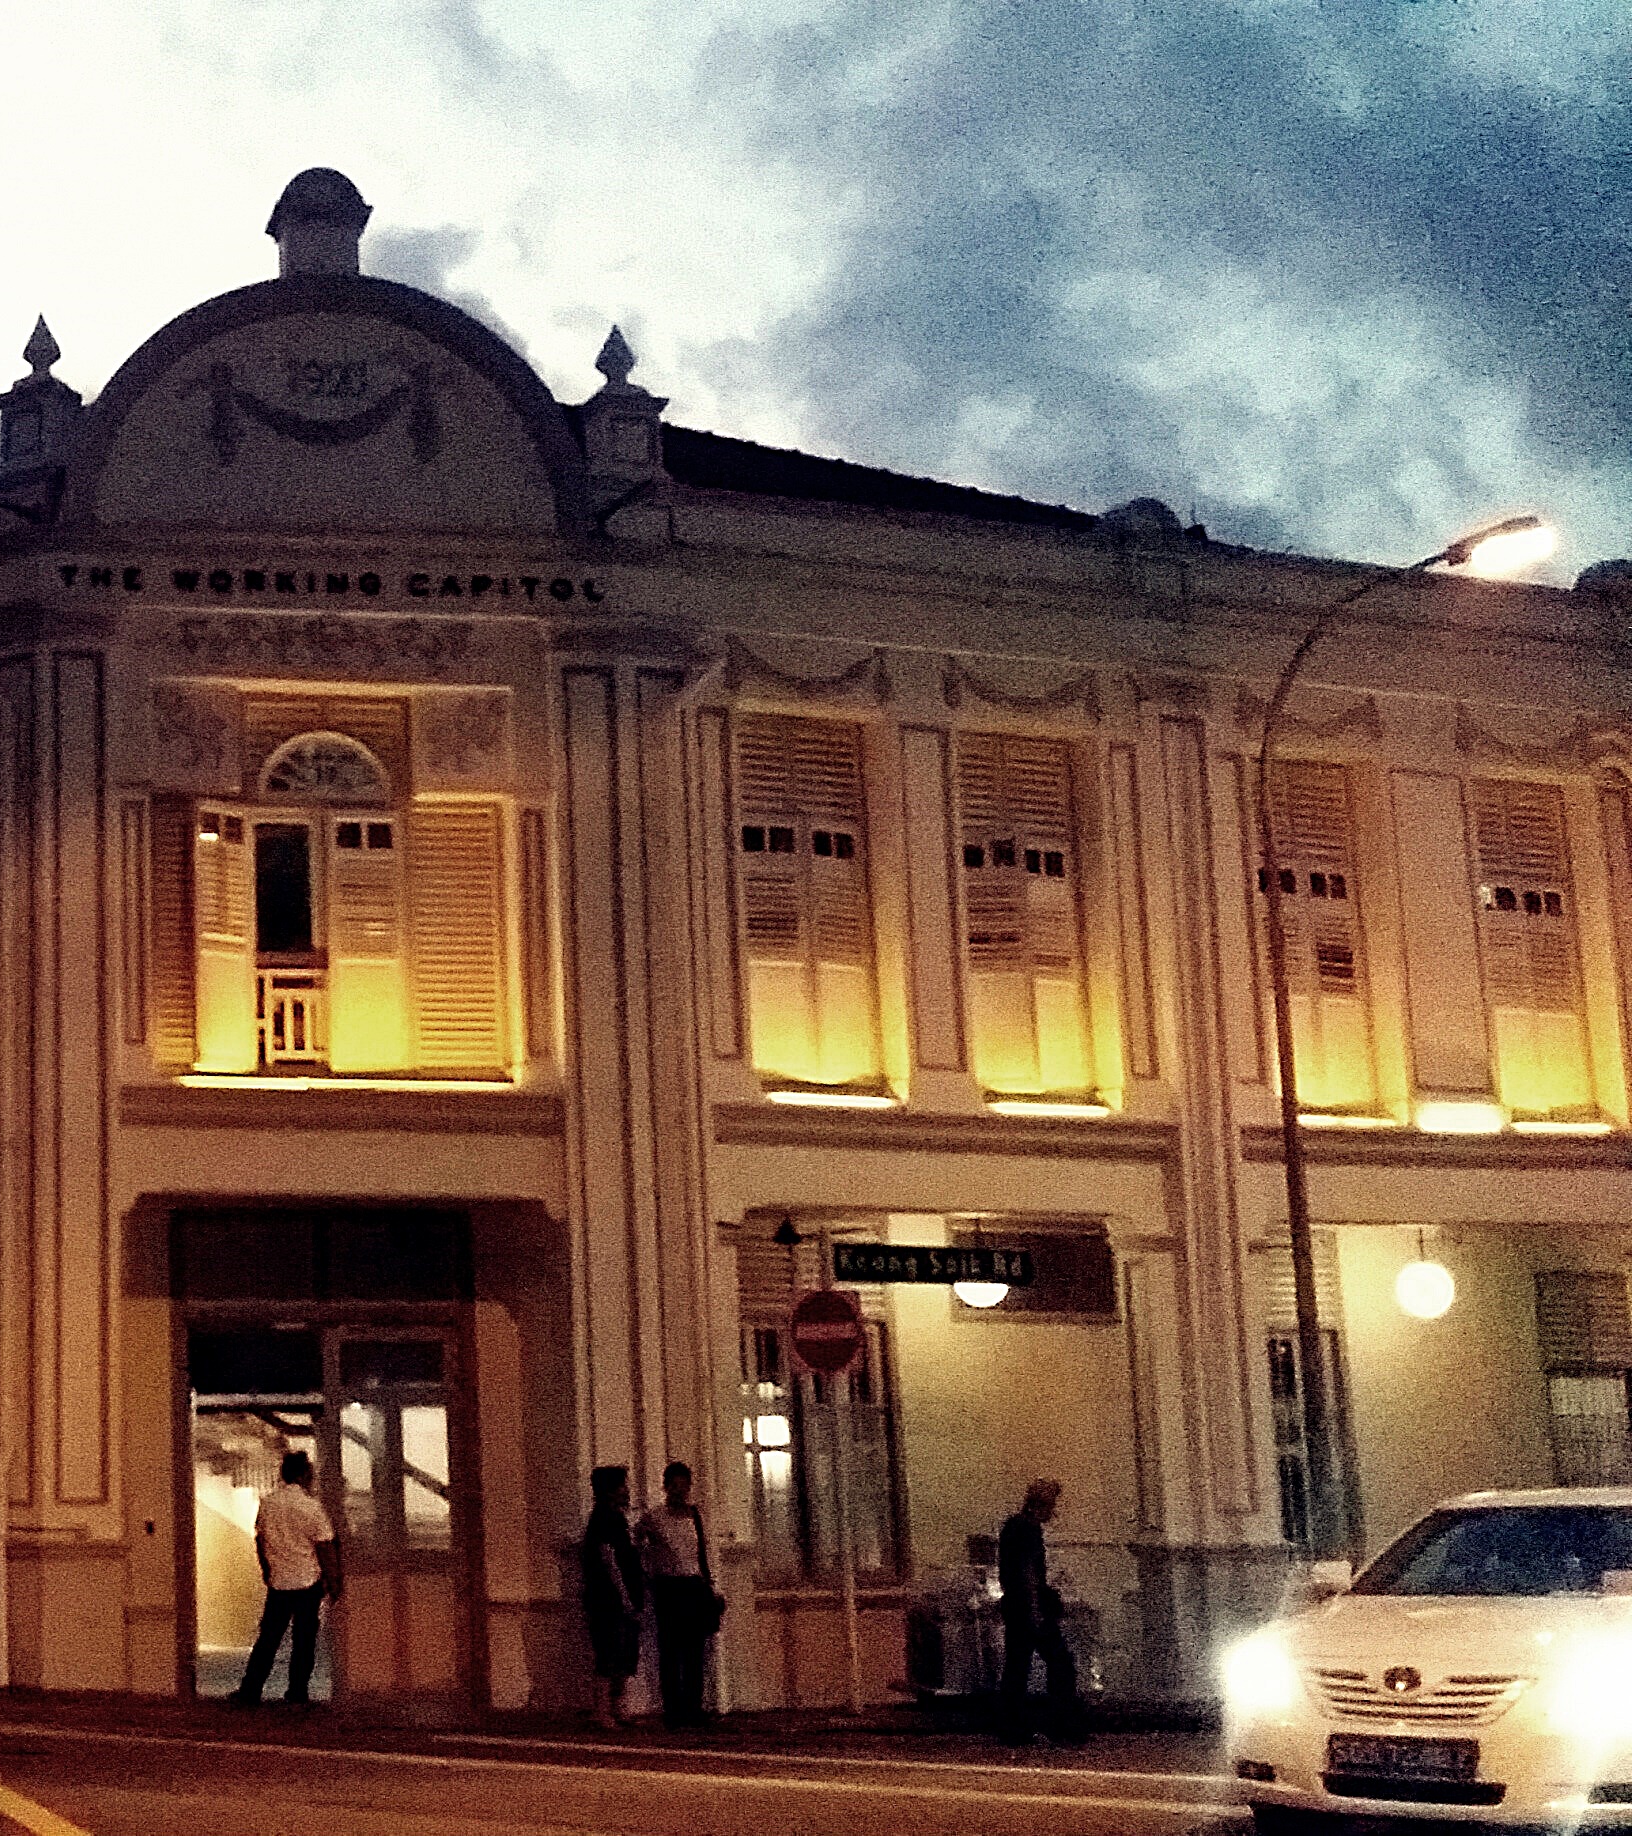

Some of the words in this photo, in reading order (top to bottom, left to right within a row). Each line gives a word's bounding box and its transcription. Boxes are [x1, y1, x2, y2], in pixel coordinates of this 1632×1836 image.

[58, 564, 142, 592] THE
[172, 568, 383, 597] WORKING
[408, 572, 605, 602] CAPITOL
[839, 1249, 919, 1278] Keong
[929, 1250, 982, 1275] Saik
[993, 1252, 1023, 1276] Rd
